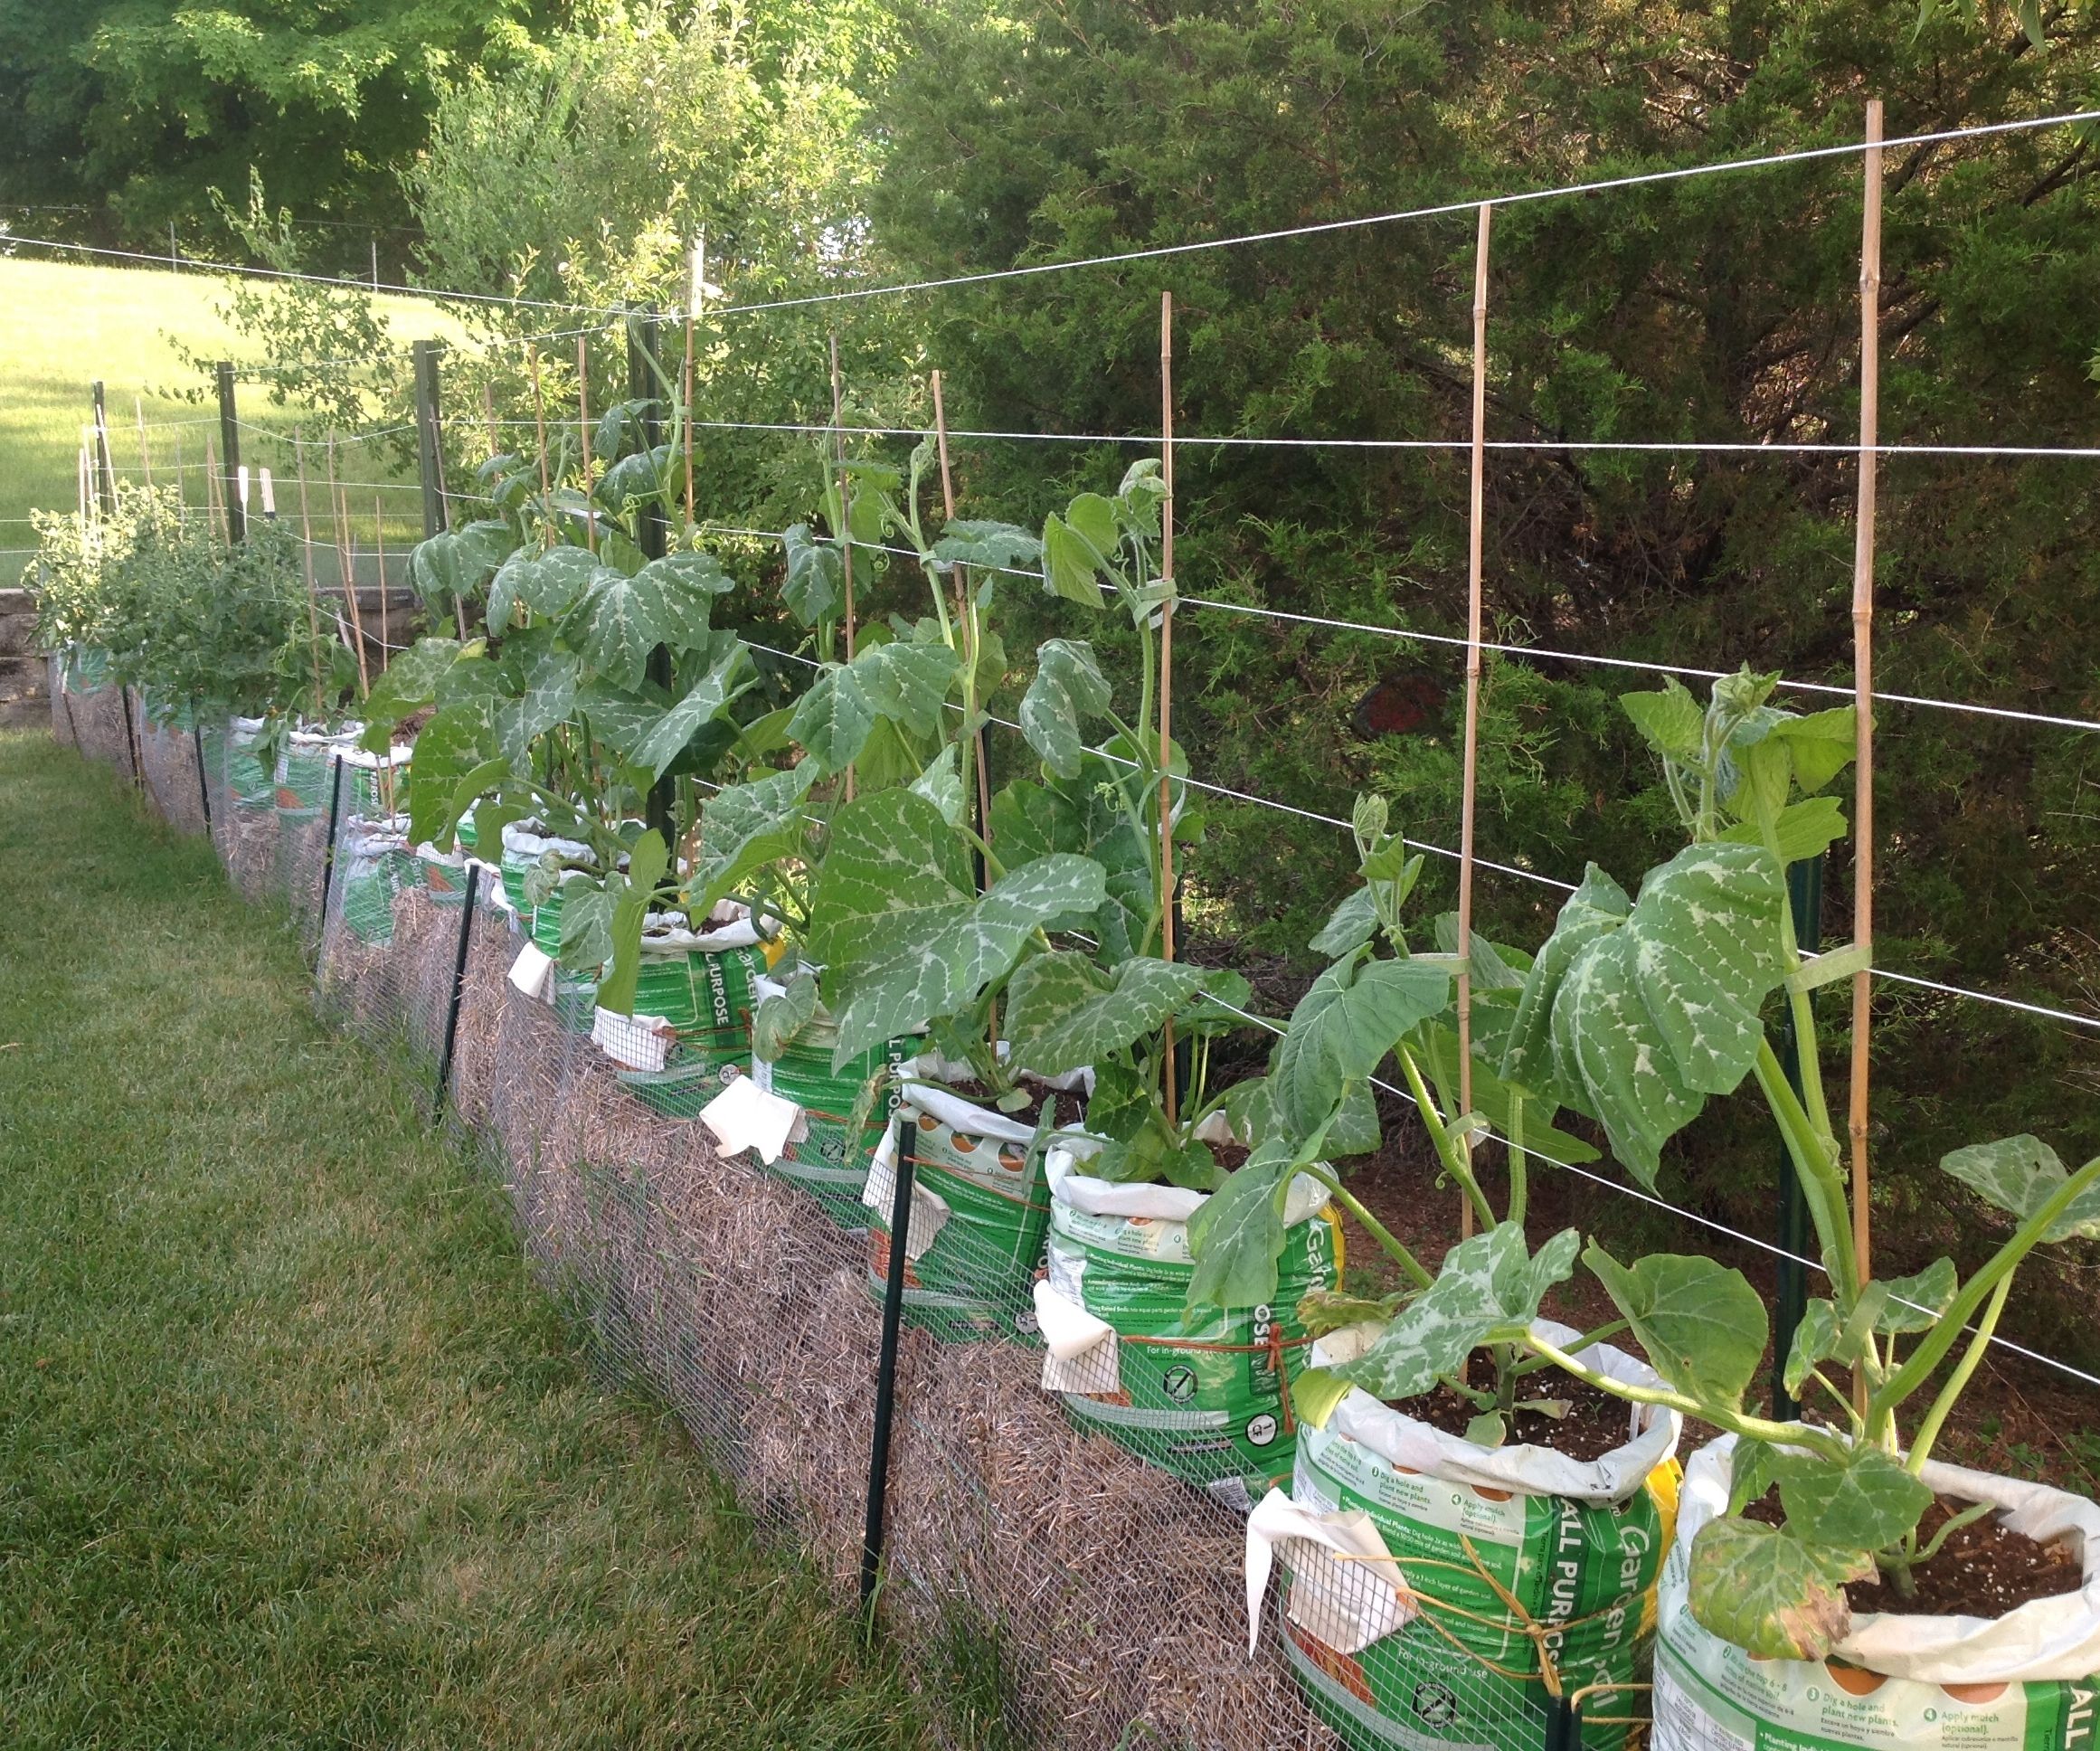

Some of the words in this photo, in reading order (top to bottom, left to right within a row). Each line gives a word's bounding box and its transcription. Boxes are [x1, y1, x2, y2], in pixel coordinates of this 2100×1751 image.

[1147, 1346, 1159, 1354] For
[1252, 1424, 1263, 1437] CF
[1558, 1498, 1582, 1553] ALL
[1603, 1525, 1650, 1651] Garden
[1537, 1560, 1578, 1673] PURPOS
[1398, 1648, 1413, 1660] For
[1415, 1656, 1467, 1675] in-ground
[1823, 1693, 1838, 1707] Dig
[1847, 1700, 1866, 1711] hole
[1868, 1703, 1886, 1713] and
[1821, 1706, 1845, 1718] plant
[1847, 1713, 1866, 1722] new
[1868, 1714, 1898, 1727] plants.
[1941, 1711, 1968, 1722] Apply
[1971, 1713, 2000, 1722] mulch
[2065, 1686, 2094, 1750] ALL
